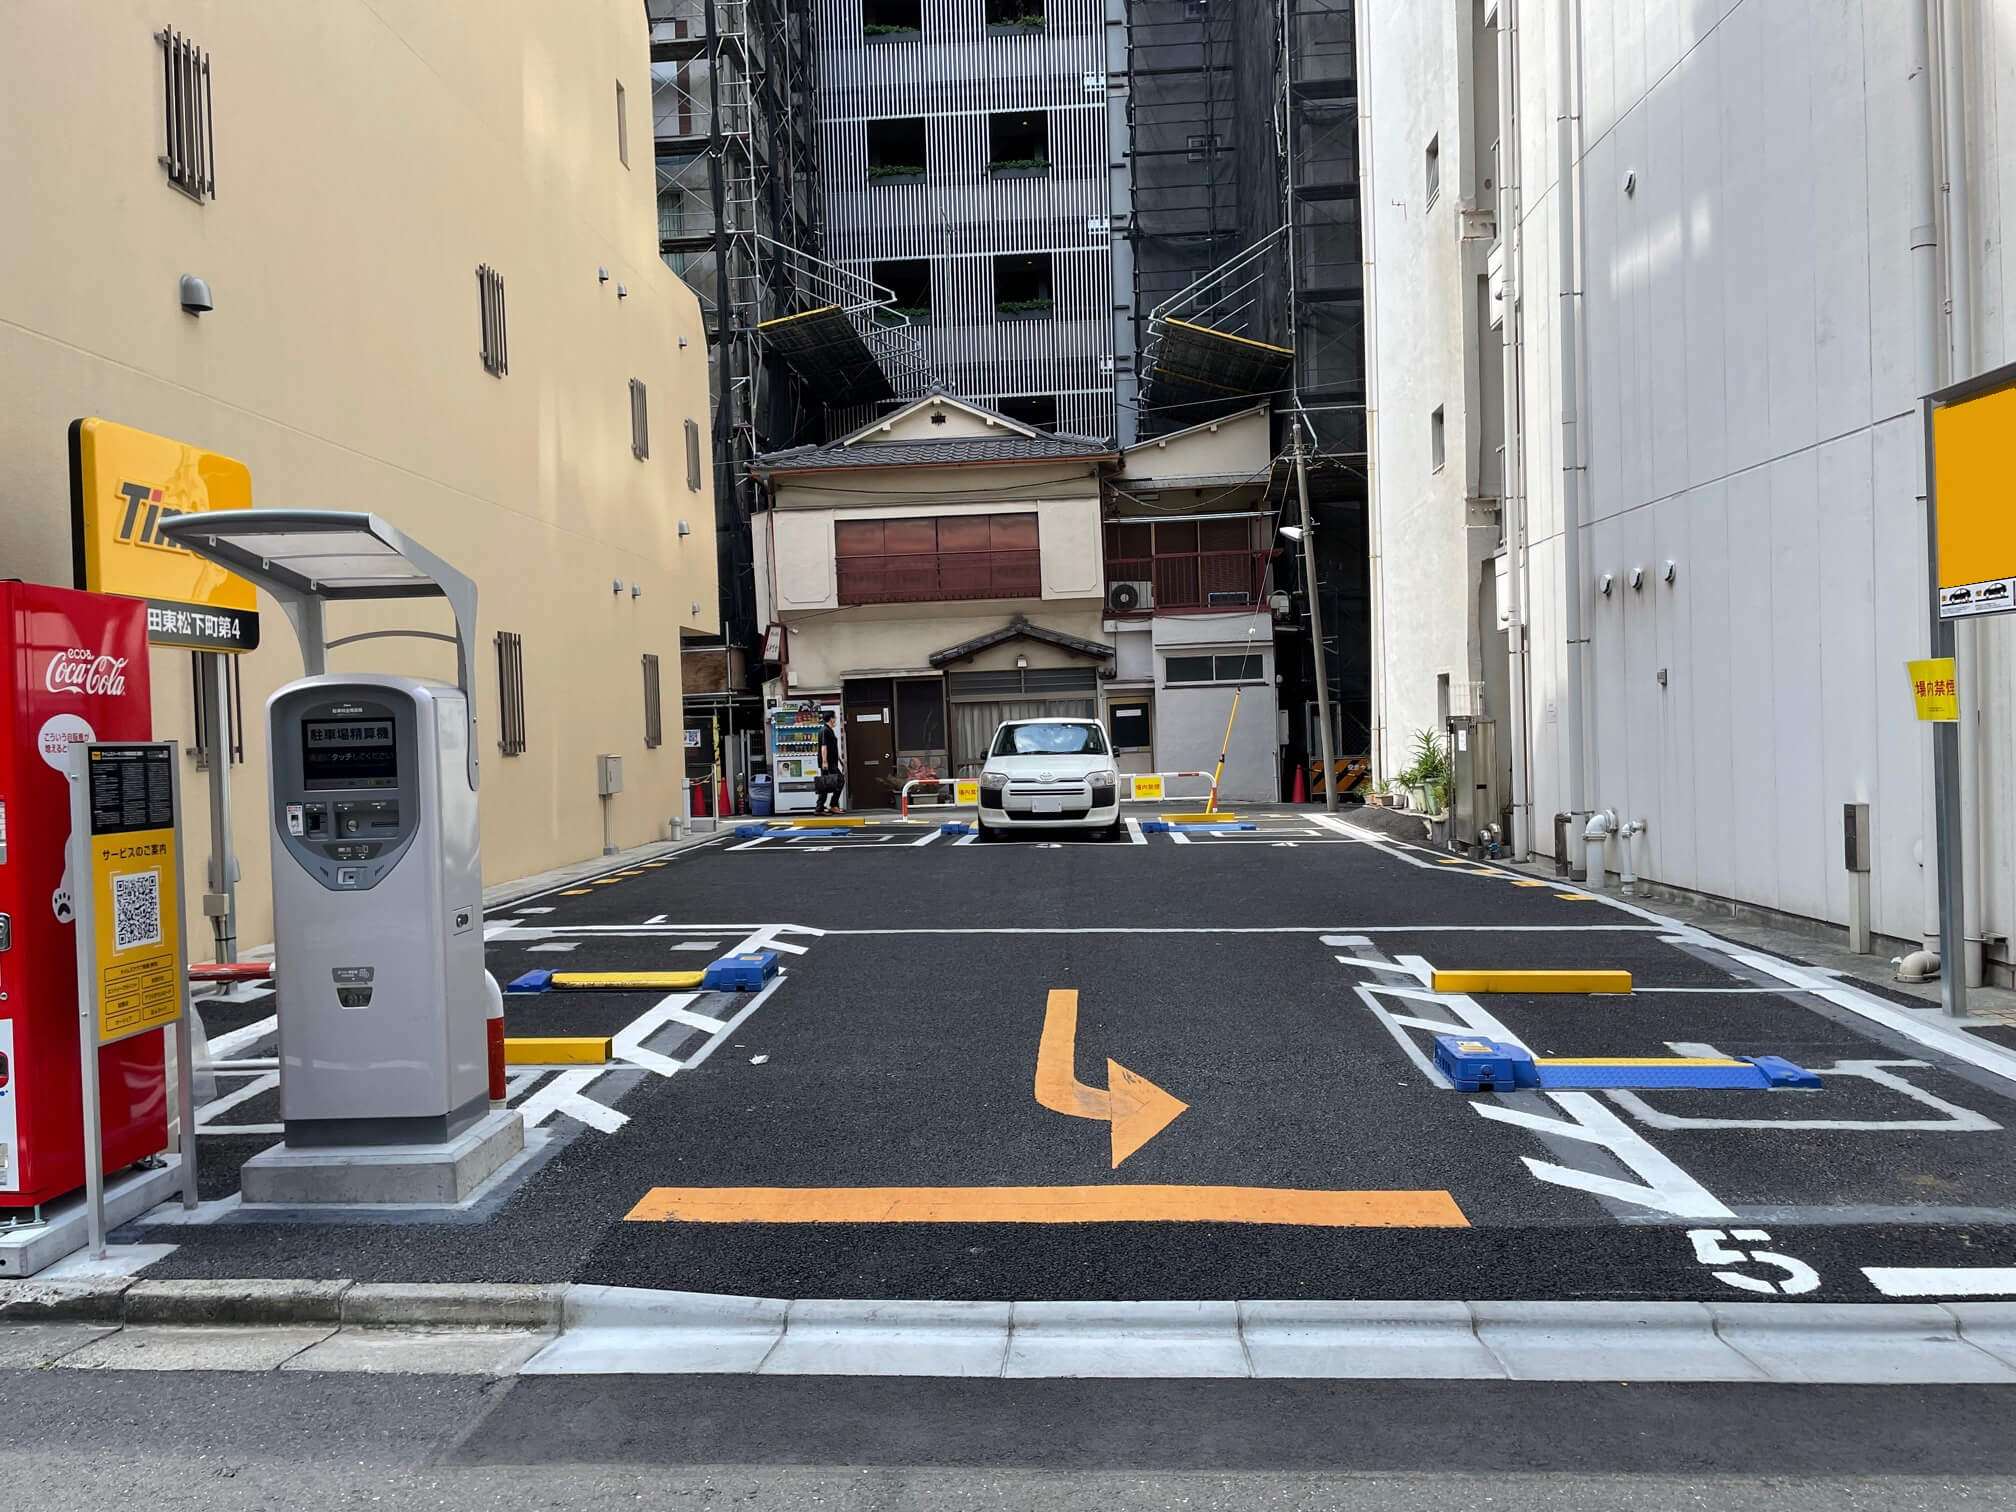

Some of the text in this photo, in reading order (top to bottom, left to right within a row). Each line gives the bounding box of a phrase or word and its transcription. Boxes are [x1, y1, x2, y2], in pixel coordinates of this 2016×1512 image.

[46, 652, 128, 696] Coca-Cola
[1915, 679, 1956, 698] 場内禁煙
[310, 726, 389, 741] 駐車場精算機
[102, 843, 168, 862] サービスのご案内
[1686, 1229, 1822, 1294] 5
